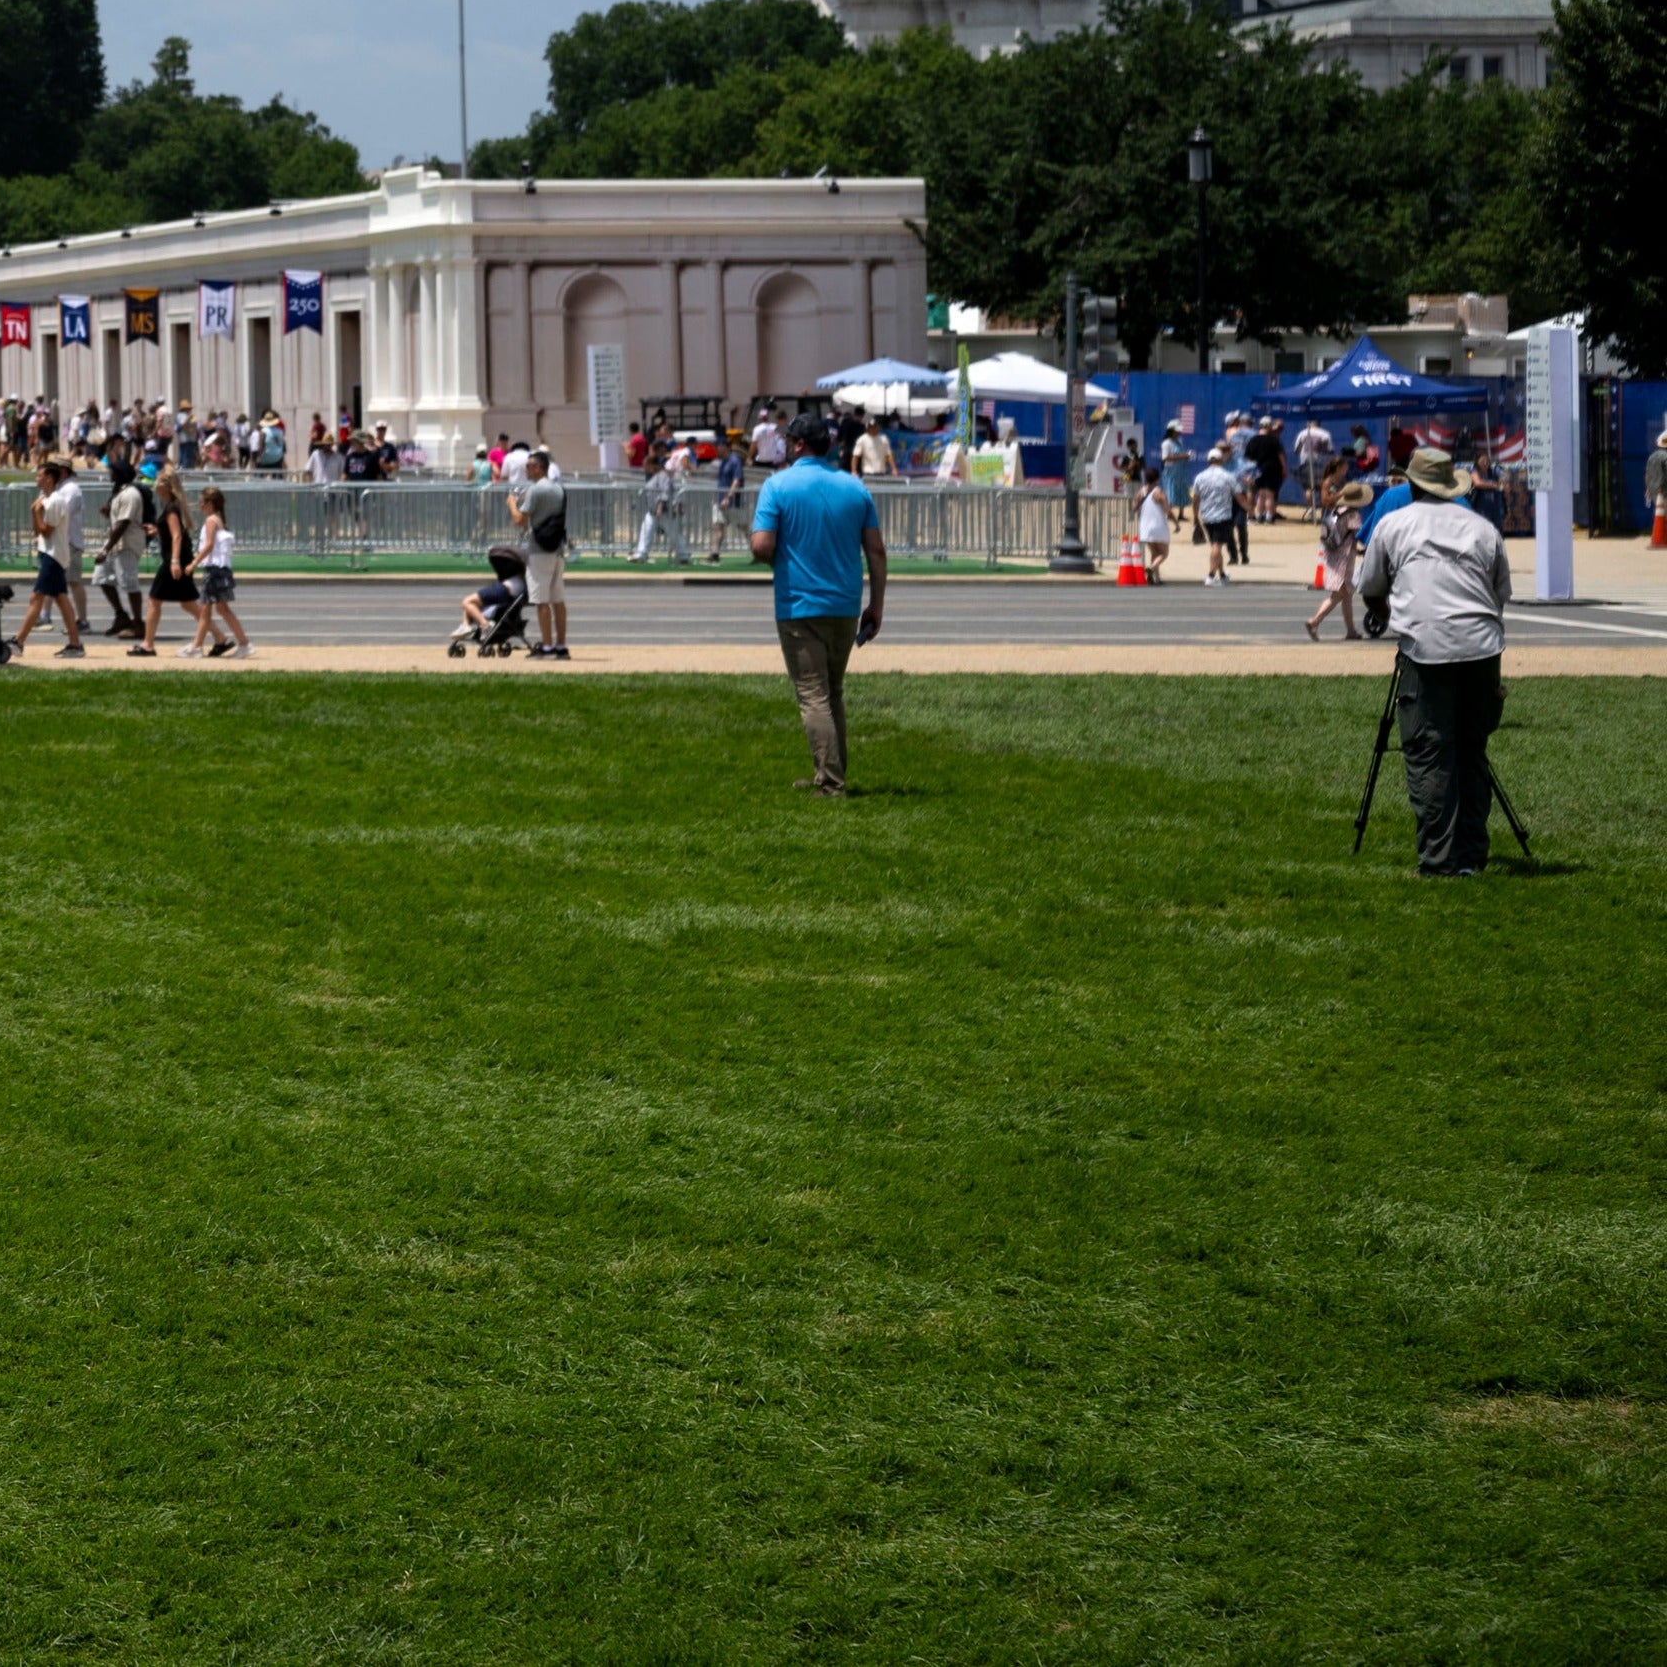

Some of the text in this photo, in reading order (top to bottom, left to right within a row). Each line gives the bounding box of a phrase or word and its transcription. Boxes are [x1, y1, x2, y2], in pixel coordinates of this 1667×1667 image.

[206, 305, 228, 329] PR
[289, 298, 320, 316] 250
[5, 320, 27, 340] TN
[64, 314, 86, 337] LA
[131, 312, 155, 334] MS
[1351, 372, 1412, 388] FIRST
